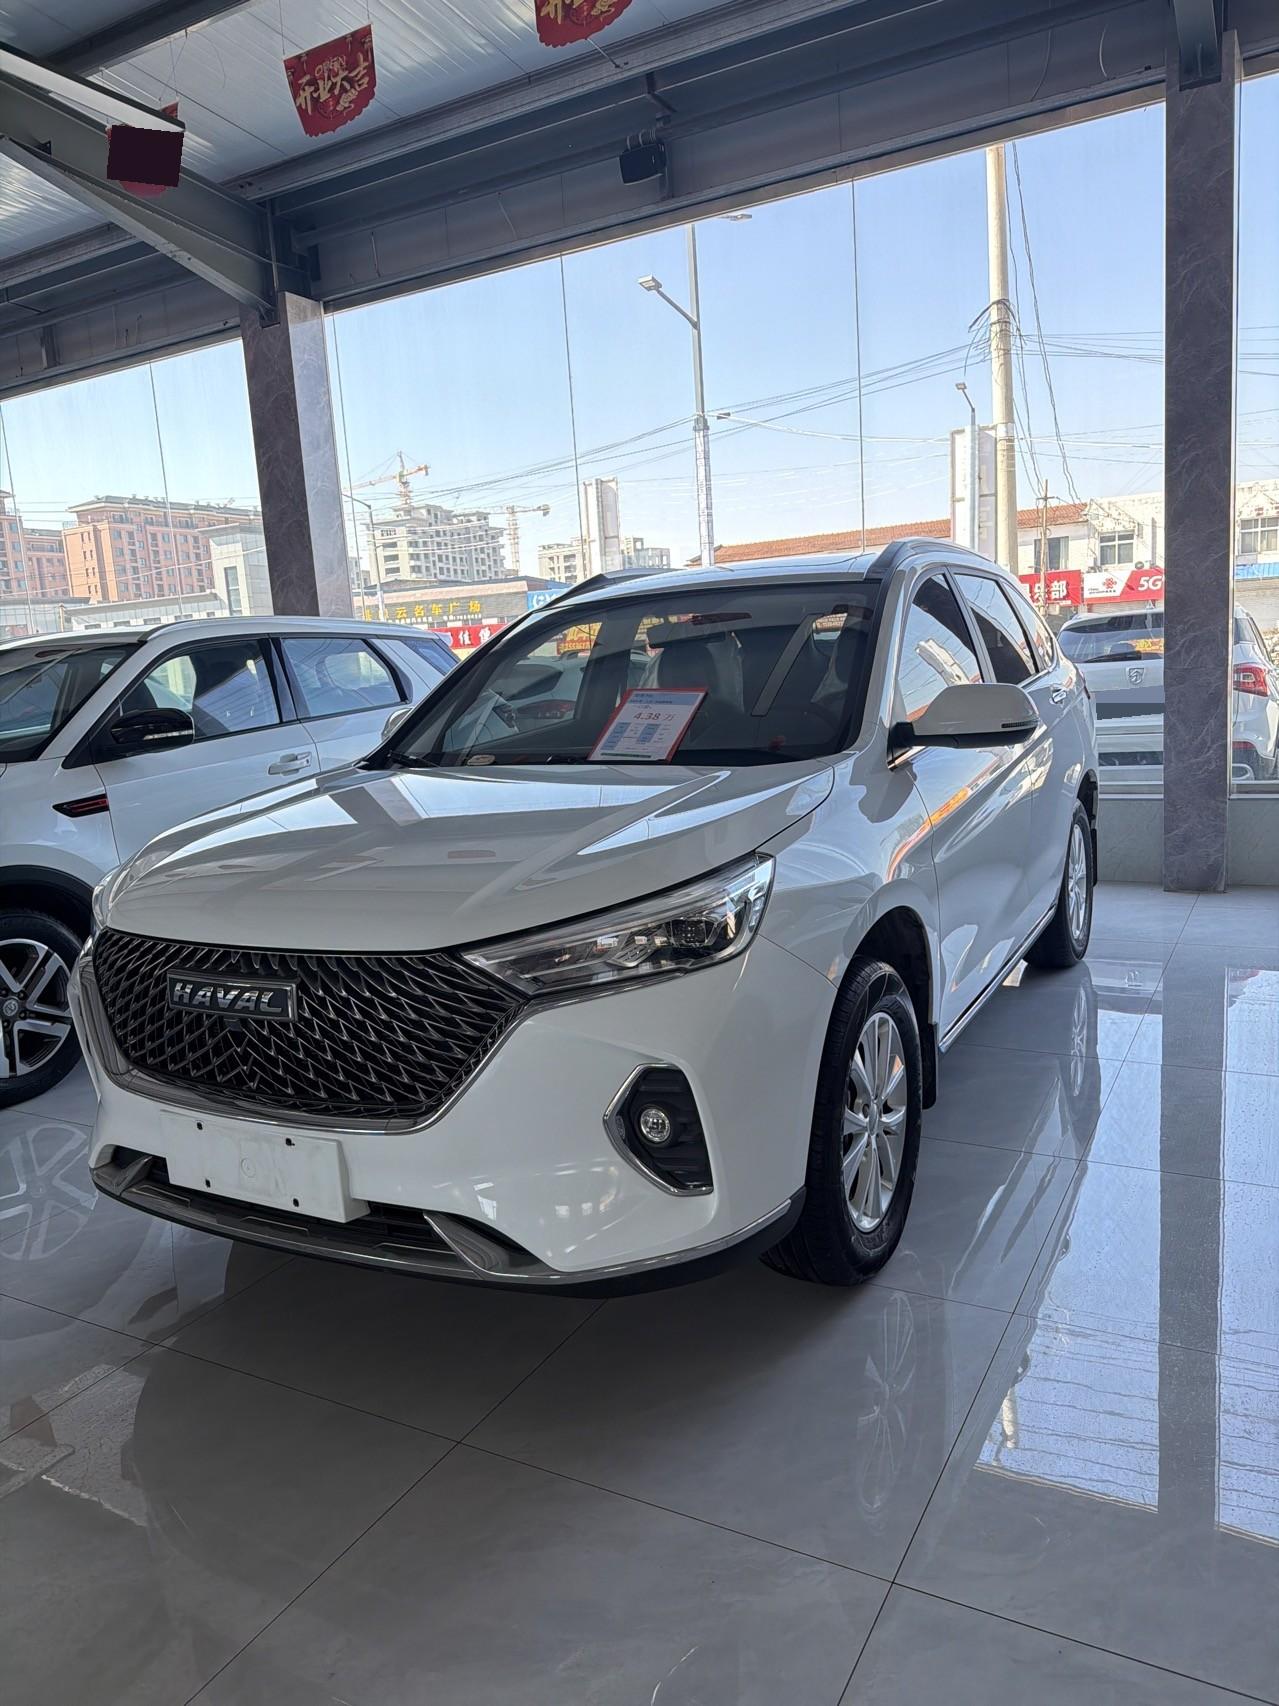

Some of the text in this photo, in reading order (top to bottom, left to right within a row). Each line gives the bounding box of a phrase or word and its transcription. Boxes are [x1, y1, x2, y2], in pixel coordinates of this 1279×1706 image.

[315, 54, 346, 77] OPEN
[296, 52, 370, 115] 开业大吉
[1138, 575, 1163, 591] 5G
[173, 982, 283, 1014] HAVAL
